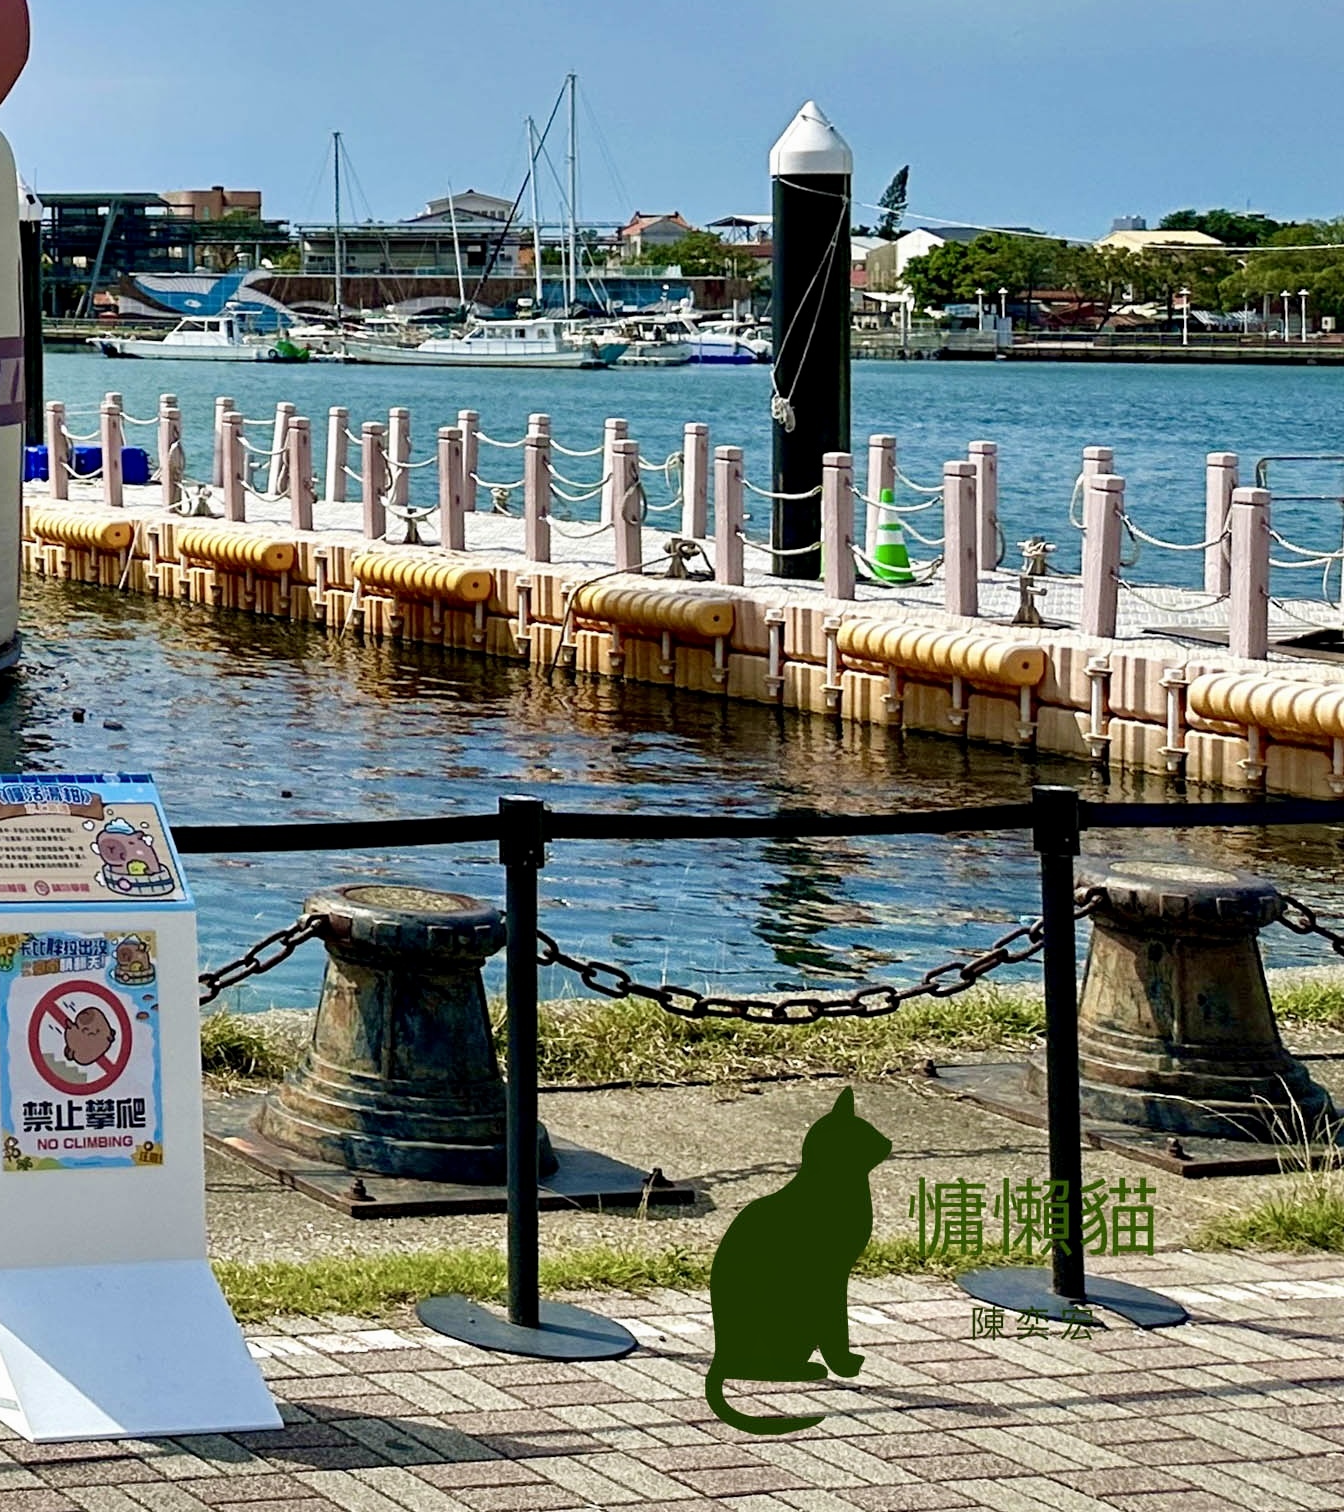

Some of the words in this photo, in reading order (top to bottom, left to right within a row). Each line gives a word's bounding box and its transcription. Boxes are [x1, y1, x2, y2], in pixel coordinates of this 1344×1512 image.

[23, 1098, 146, 1132] 禁止攀爬
[37, 1138, 58, 1150] NO
[64, 1136, 133, 1149] CLIMBING
